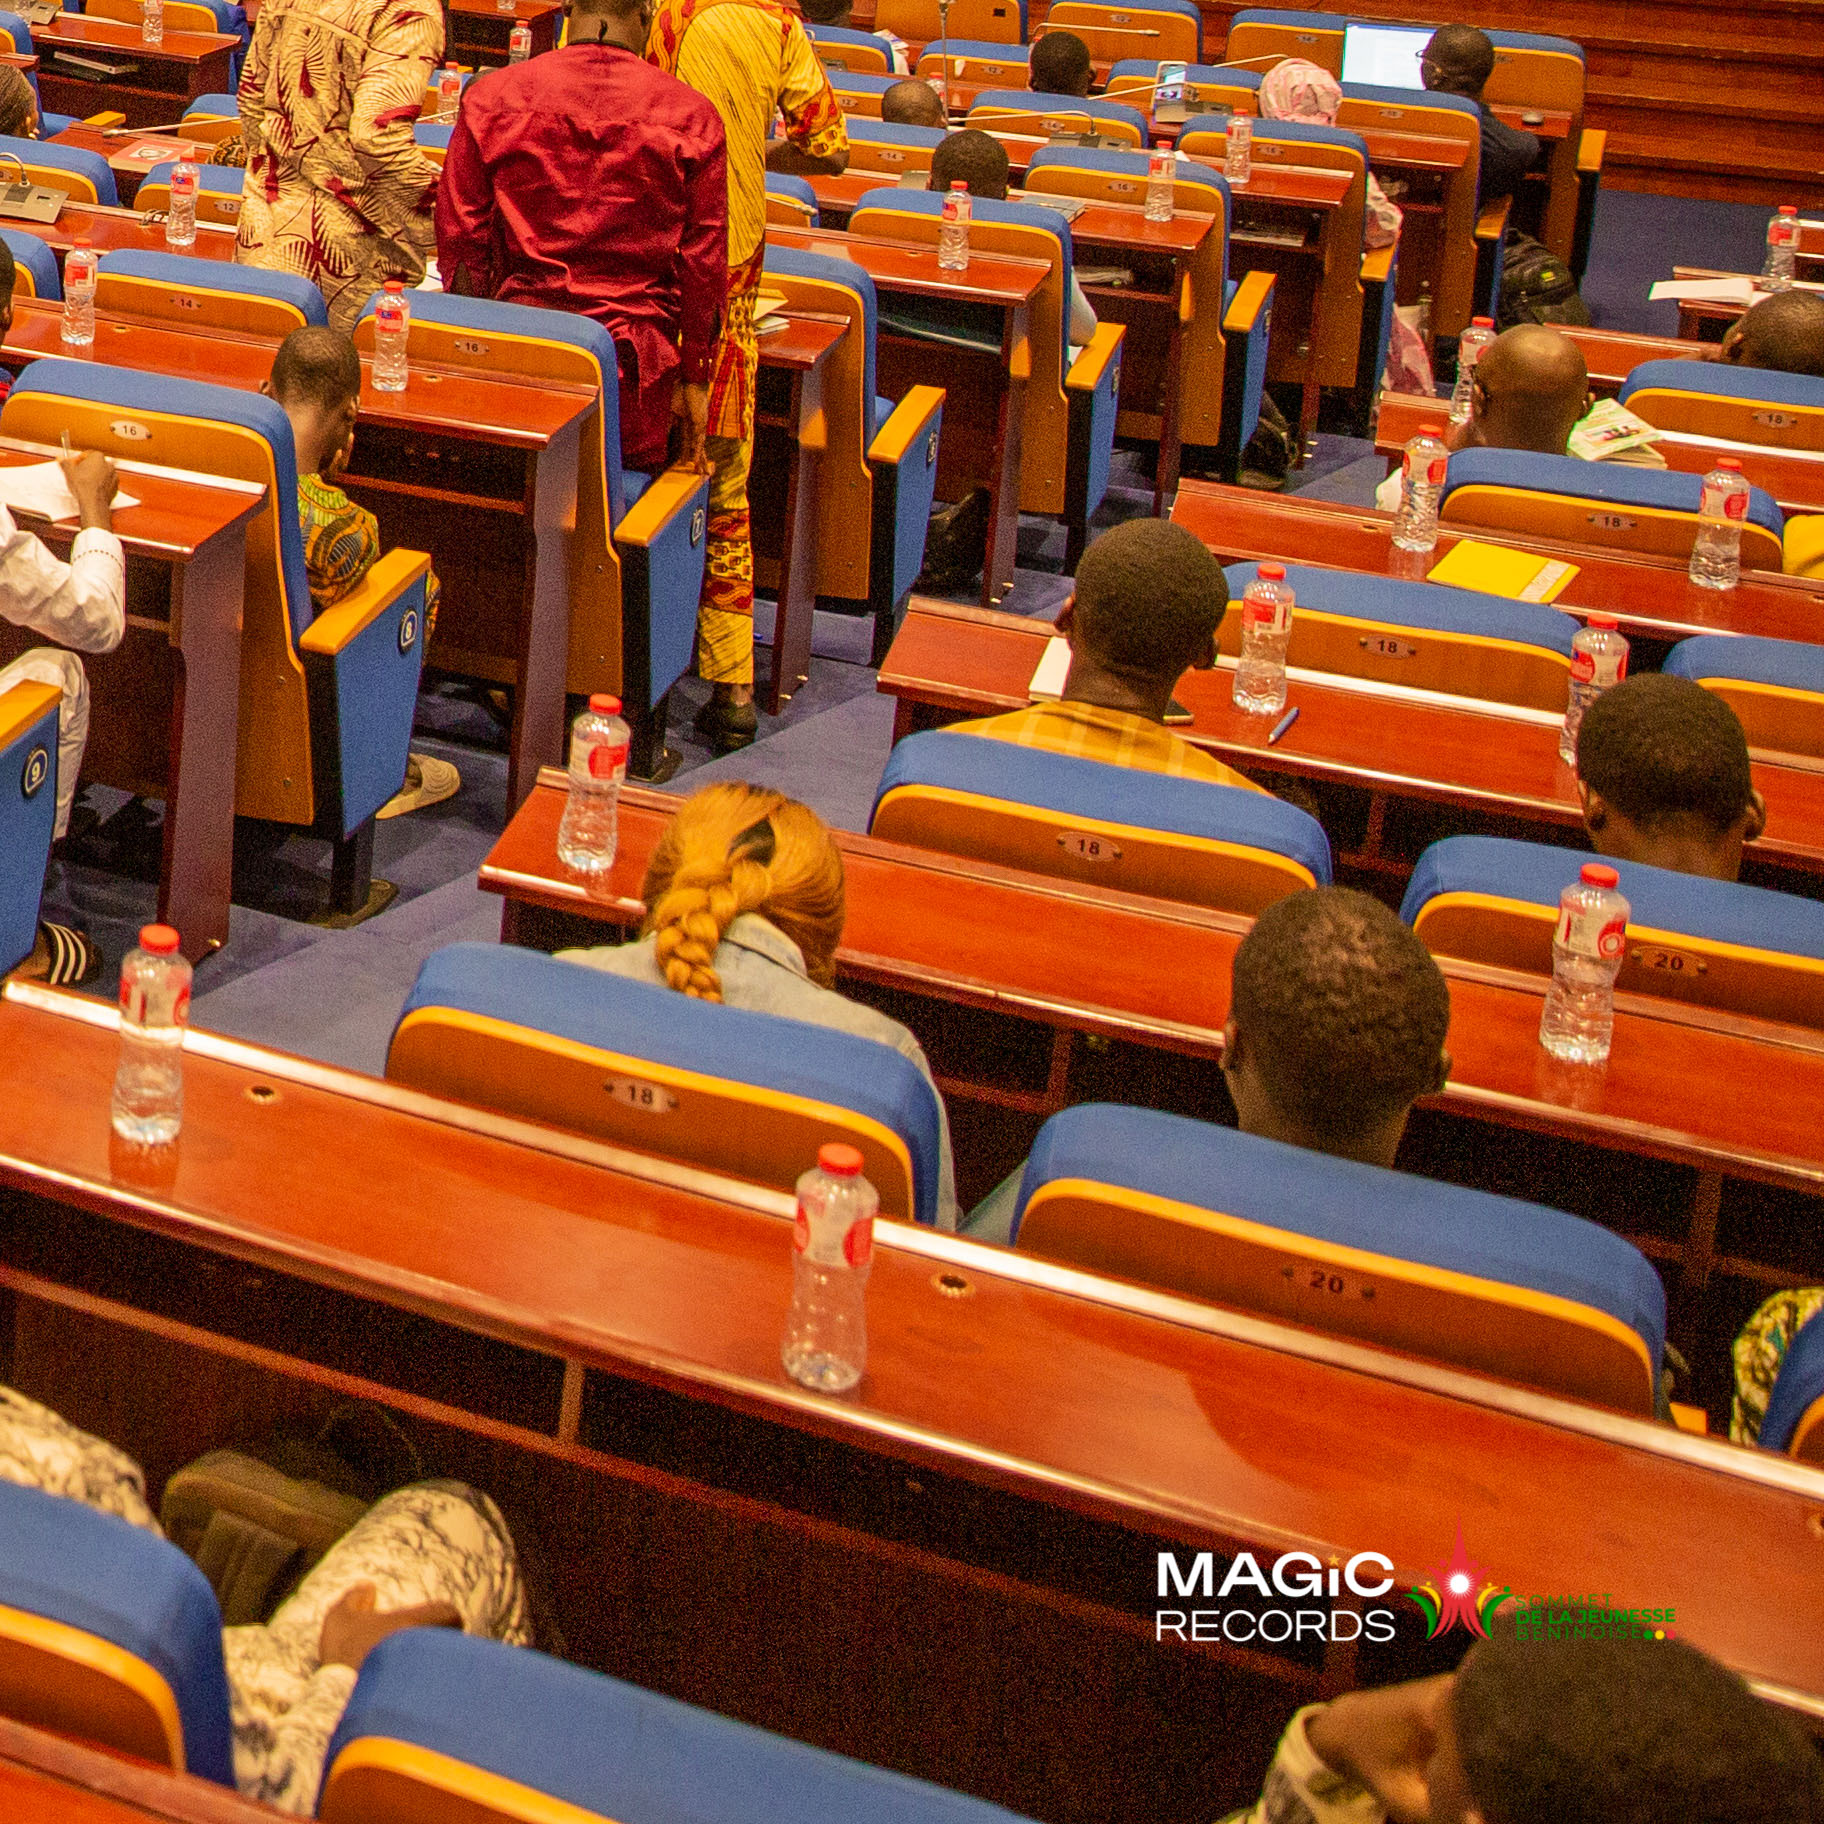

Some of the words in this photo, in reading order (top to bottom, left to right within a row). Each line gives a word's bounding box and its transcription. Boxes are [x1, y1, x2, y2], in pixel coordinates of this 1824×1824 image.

[1118, 182, 1128, 191] 16
[223, 203, 234, 211] 12
[180, 299, 192, 308] 14
[465, 342, 478, 353] 16
[1768, 414, 1782, 424] 18
[123, 425, 137, 436] 16
[1604, 516, 1621, 527] 18
[1377, 640, 1397, 653] 18
[32, 763, 41, 781] 9
[1080, 839, 1100, 854] 18
[1655, 952, 1684, 970] 20
[630, 1084, 653, 1105] 18
[1310, 1271, 1344, 1294] 20
